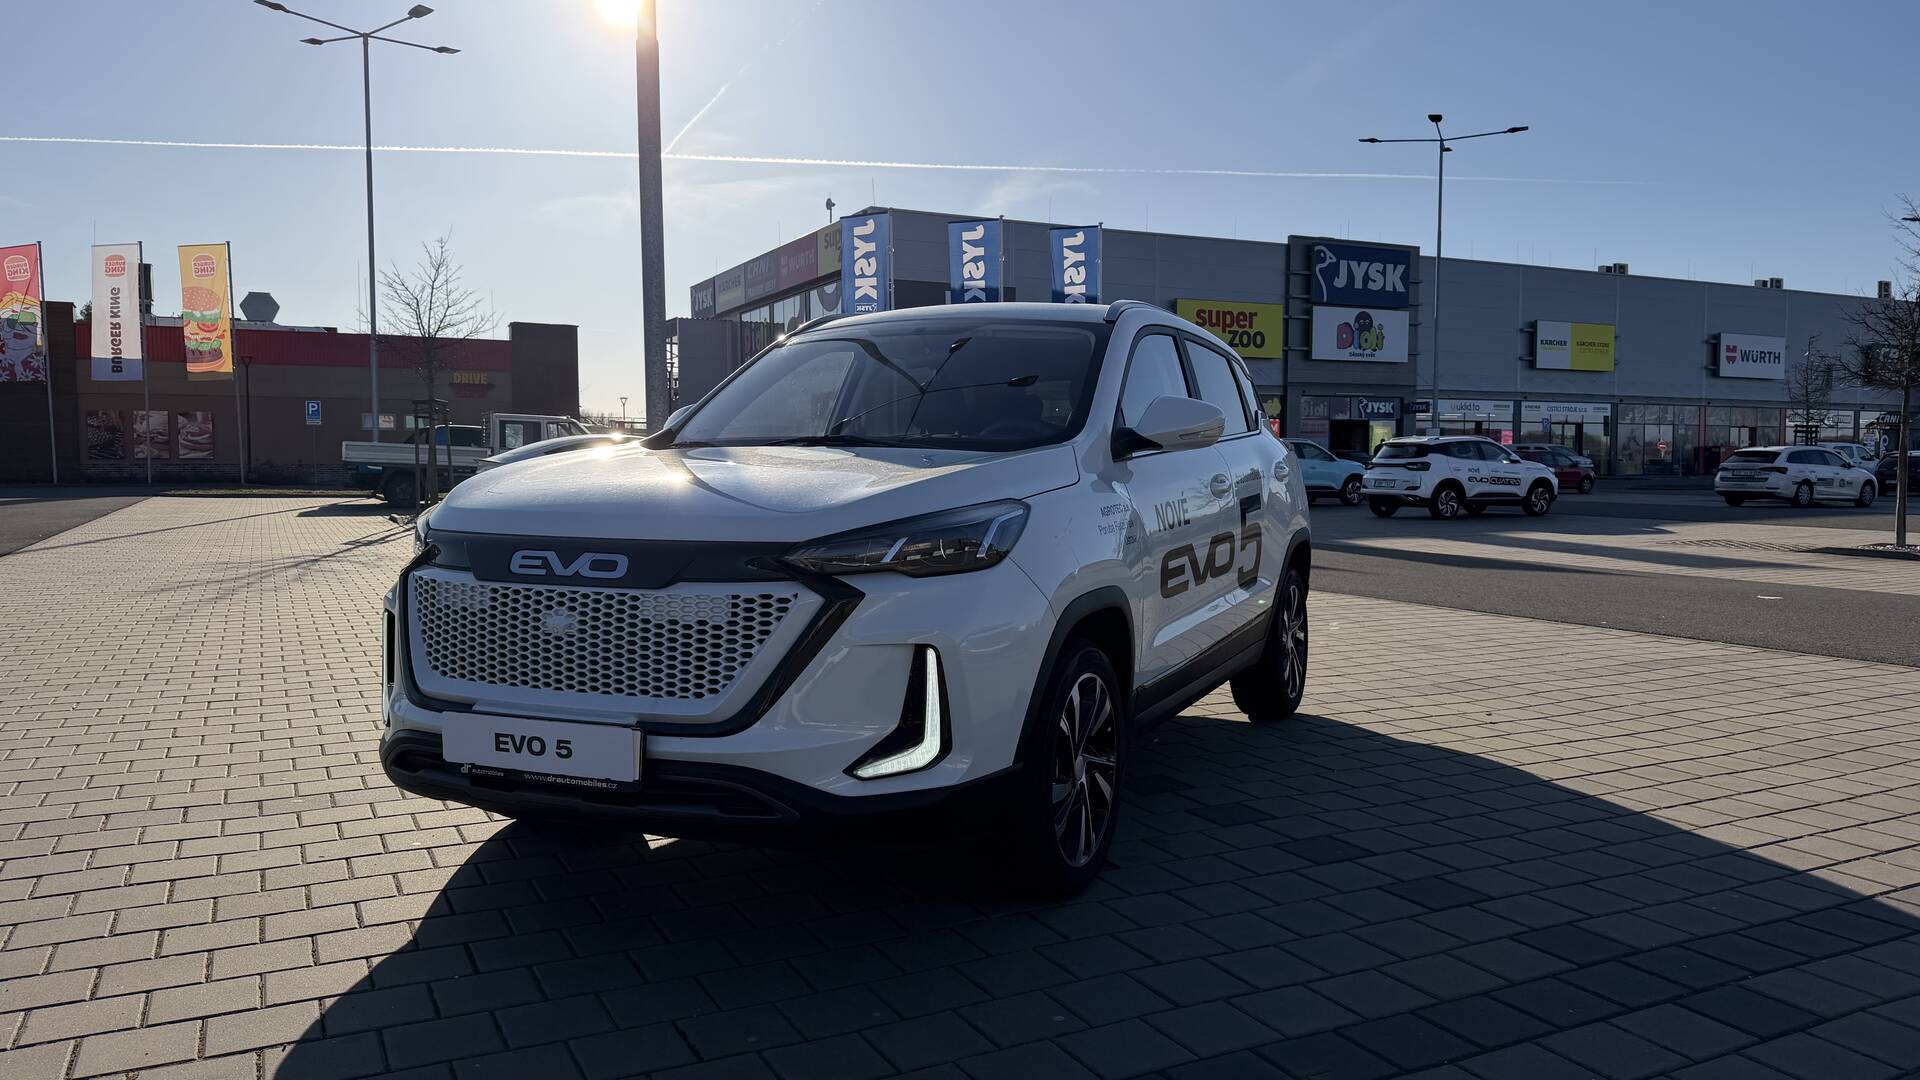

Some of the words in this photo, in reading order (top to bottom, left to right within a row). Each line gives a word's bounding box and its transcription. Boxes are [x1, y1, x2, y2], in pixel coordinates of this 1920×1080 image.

[1333, 259, 1406, 292] JYSK
[694, 287, 713, 312] JYSK
[1195, 309, 1257, 333] super
[1739, 348, 1780, 365] WÜRTH
[454, 371, 488, 385] DRIVE
[309, 403, 318, 415] P
[1366, 401, 1394, 413] JYSK
[1468, 476, 1489, 484] EVO
[1490, 477, 1521, 485] CUATRO
[1155, 491, 1190, 532] NOVÉ
[1160, 531, 1235, 599] EVO
[1238, 493, 1262, 591] 5
[510, 549, 629, 579] EVO
[494, 732, 546, 757] EVO
[556, 739, 573, 759] 5
[524, 775, 618, 790] www.drautomobiles.cz
